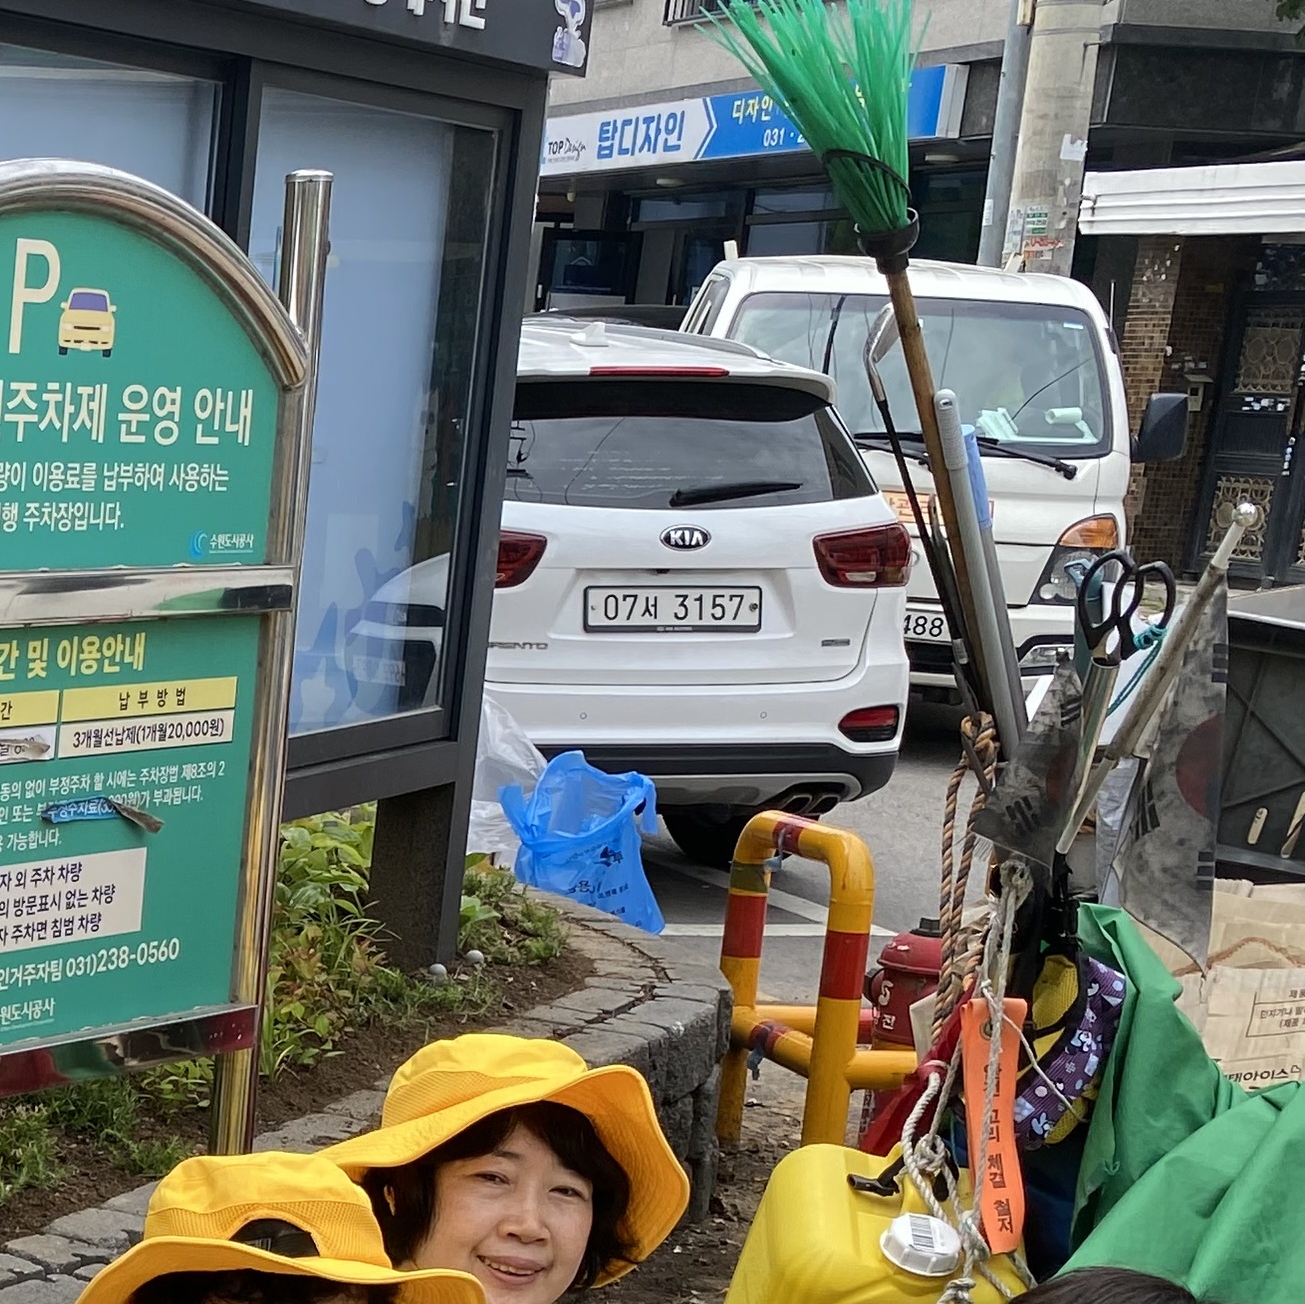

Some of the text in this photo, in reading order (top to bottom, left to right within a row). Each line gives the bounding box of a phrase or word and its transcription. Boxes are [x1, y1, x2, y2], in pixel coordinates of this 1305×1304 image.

[548, 140, 564, 155] TOP
[596, 110, 686, 160] 탑디자인
[8, 237, 61, 354] P
[118, 383, 182, 446] 운영
[194, 387, 254, 447] 안내
[32, 461, 97, 492] 이용료를
[103, 462, 165, 492] 납부하여
[169, 463, 230, 492] 사용하는
[22, 501, 125, 533] 주차장입니다.
[209, 532, 254, 550] 수원도시공사
[669, 530, 704, 547] KIA
[603, 594, 745, 621] 07서 3157
[27, 637, 49, 679] 및
[57, 632, 147, 677] 이용안내
[0, 781, 22, 800] 동의
[24, 778, 46, 799] 없이
[48, 773, 91, 797] 부정주차
[93, 771, 104, 791] 할
[106, 768, 136, 789] 시에는
[139, 764, 179, 785] 주차장법
[180, 761, 216, 782] 제8조의
[11, 803, 33, 823] 또는
[152, 784, 204, 807] 부과됩니다.
[6, 828, 62, 852] 가능합니다.
[15, 868, 28, 890] 외
[30, 864, 55, 886] 주차
[57, 861, 83, 884] 차량
[12, 889, 62, 919] 방문표시
[65, 887, 89, 911] 없는
[91, 883, 116, 906] 차량
[10, 919, 48, 944] 주차면
[50, 915, 76, 938] 침범
[77, 911, 102, 934] 차량
[65, 937, 181, 978] 031)238-0560
[987, 1153, 1006, 1189] 체결
[993, 1198, 1014, 1234] 철저
